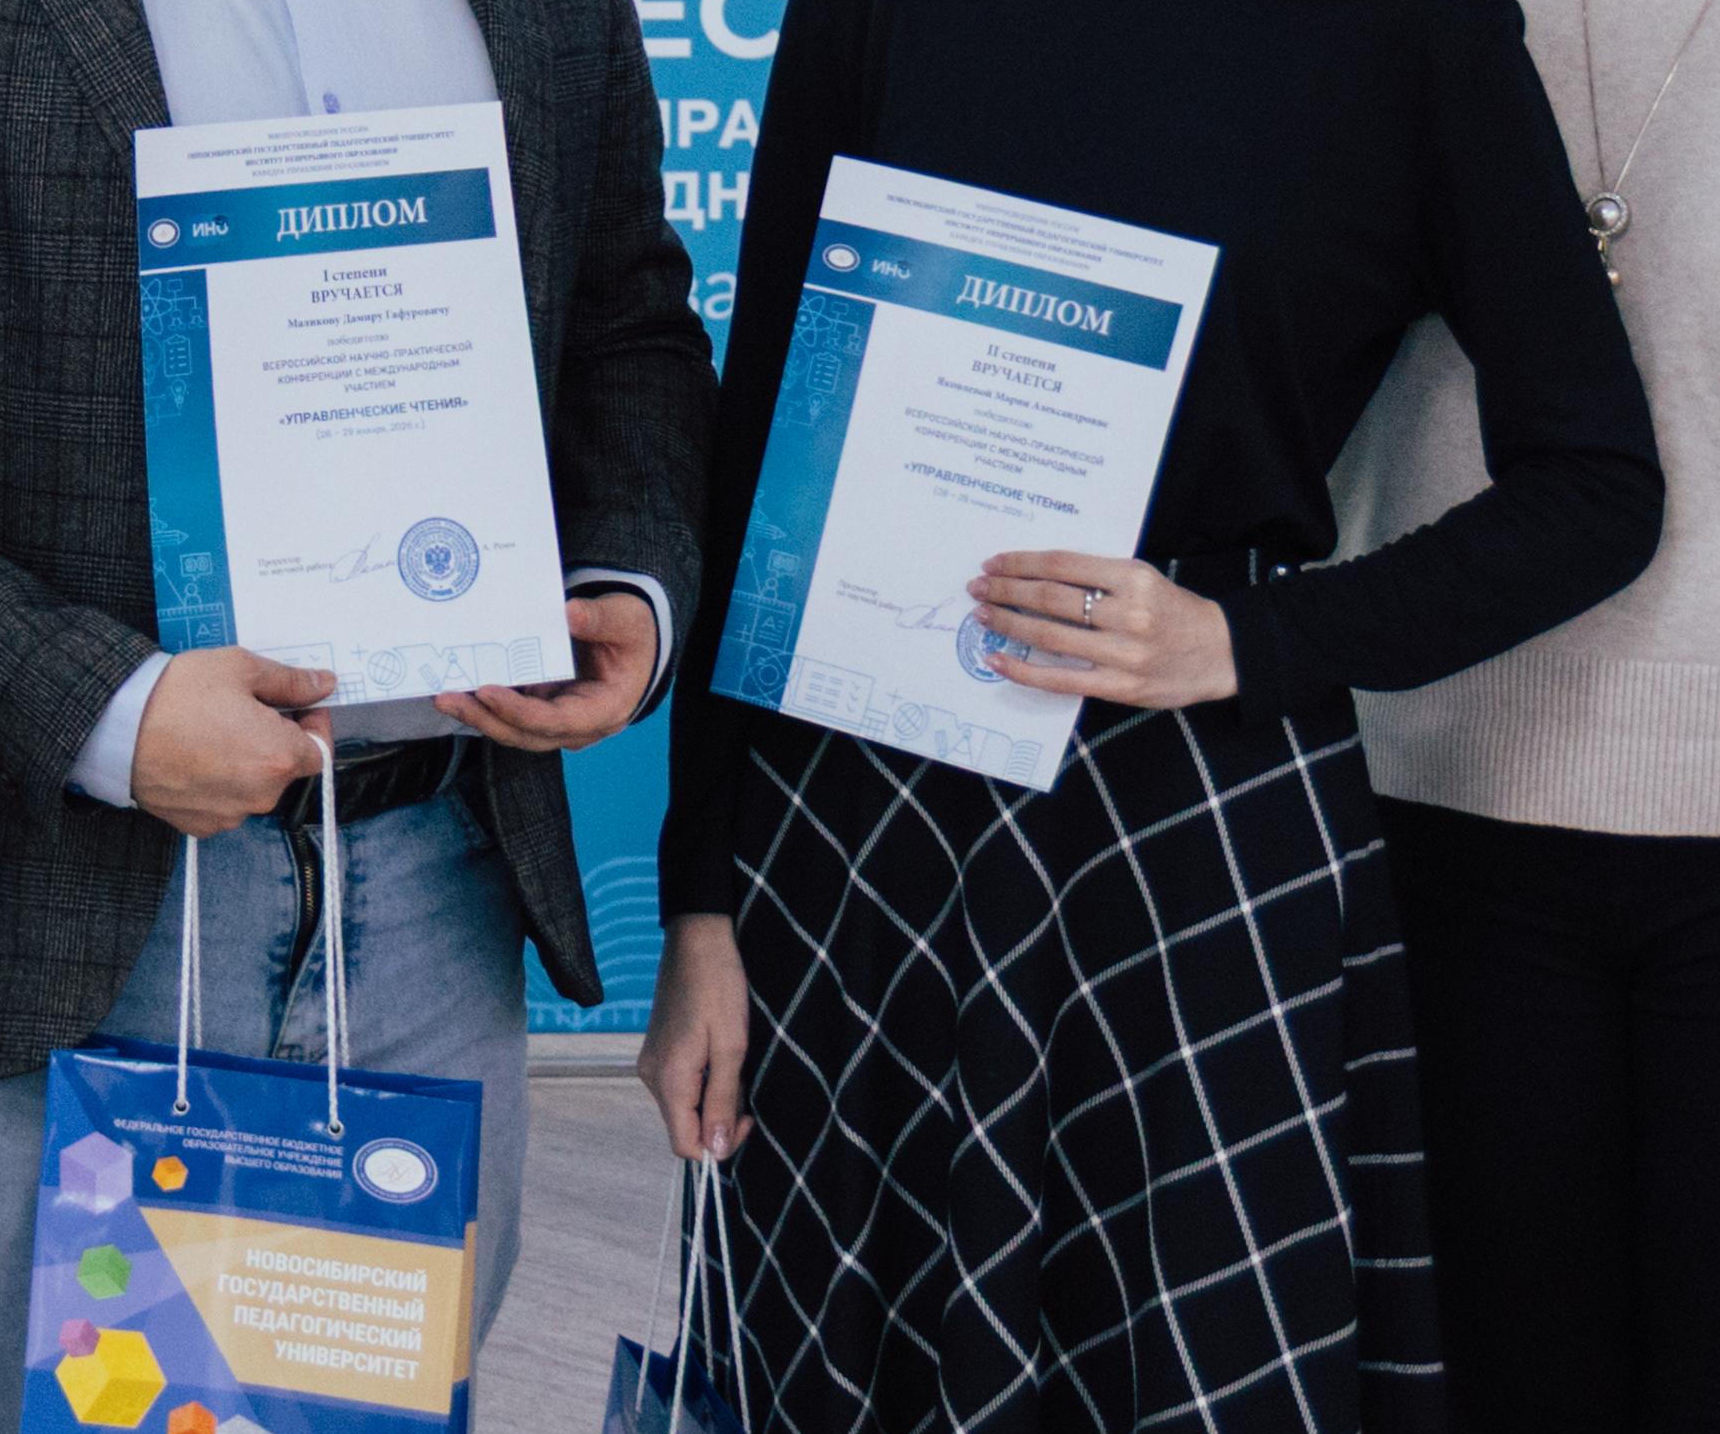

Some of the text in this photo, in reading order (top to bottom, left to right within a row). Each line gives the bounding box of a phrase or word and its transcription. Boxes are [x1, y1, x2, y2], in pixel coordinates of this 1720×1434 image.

[277, 197, 427, 241] ДИПЛОМ
[323, 269, 387, 283] I степени
[311, 283, 402, 303] ВРУЧАЕТСЯ
[957, 276, 1113, 335] ДИПЛОМ
[278, 359, 460, 384] КОНФЕРЕНЦИИ С МЕЖДУНАРОДНЫМ
[987, 344, 1056, 372] II степени
[344, 380, 395, 392] УЧАСТИЕМ
[972, 360, 1062, 393] ВРУЧАЕТСЯ
[280, 397, 468, 424] «УПРАВЛЕНЧЕСКИЕ ЧТЕНИЯ»
[905, 463, 1024, 500] «УПРАВЛЕНЧЕСКИЕ
[1027, 493, 1079, 514] ЧТЕНИЯ»
[113, 1118, 344, 1156] ФЕДЕРАЛЬНОЕ ГОСУДАРСТВЕННОЕ БЮДЖЕТНОЕ
[185, 1139, 343, 1168] ОБРАЗОВАТЕЛЬНОЕ УЧРЕЖДЕНИЕ
[224, 1154, 343, 1180] ВЫСШЕГО ОБРАЗОВАНИЯ
[245, 1248, 428, 1294] НОВОСИБИРСКИЙ
[217, 1272, 425, 1323] ГОСУДАРСТВЕННЫЙ
[233, 1304, 423, 1352] ПЕДАГОГИЧЕСКИЙ
[274, 1339, 420, 1381] УНИВЕРСИТЕТ
